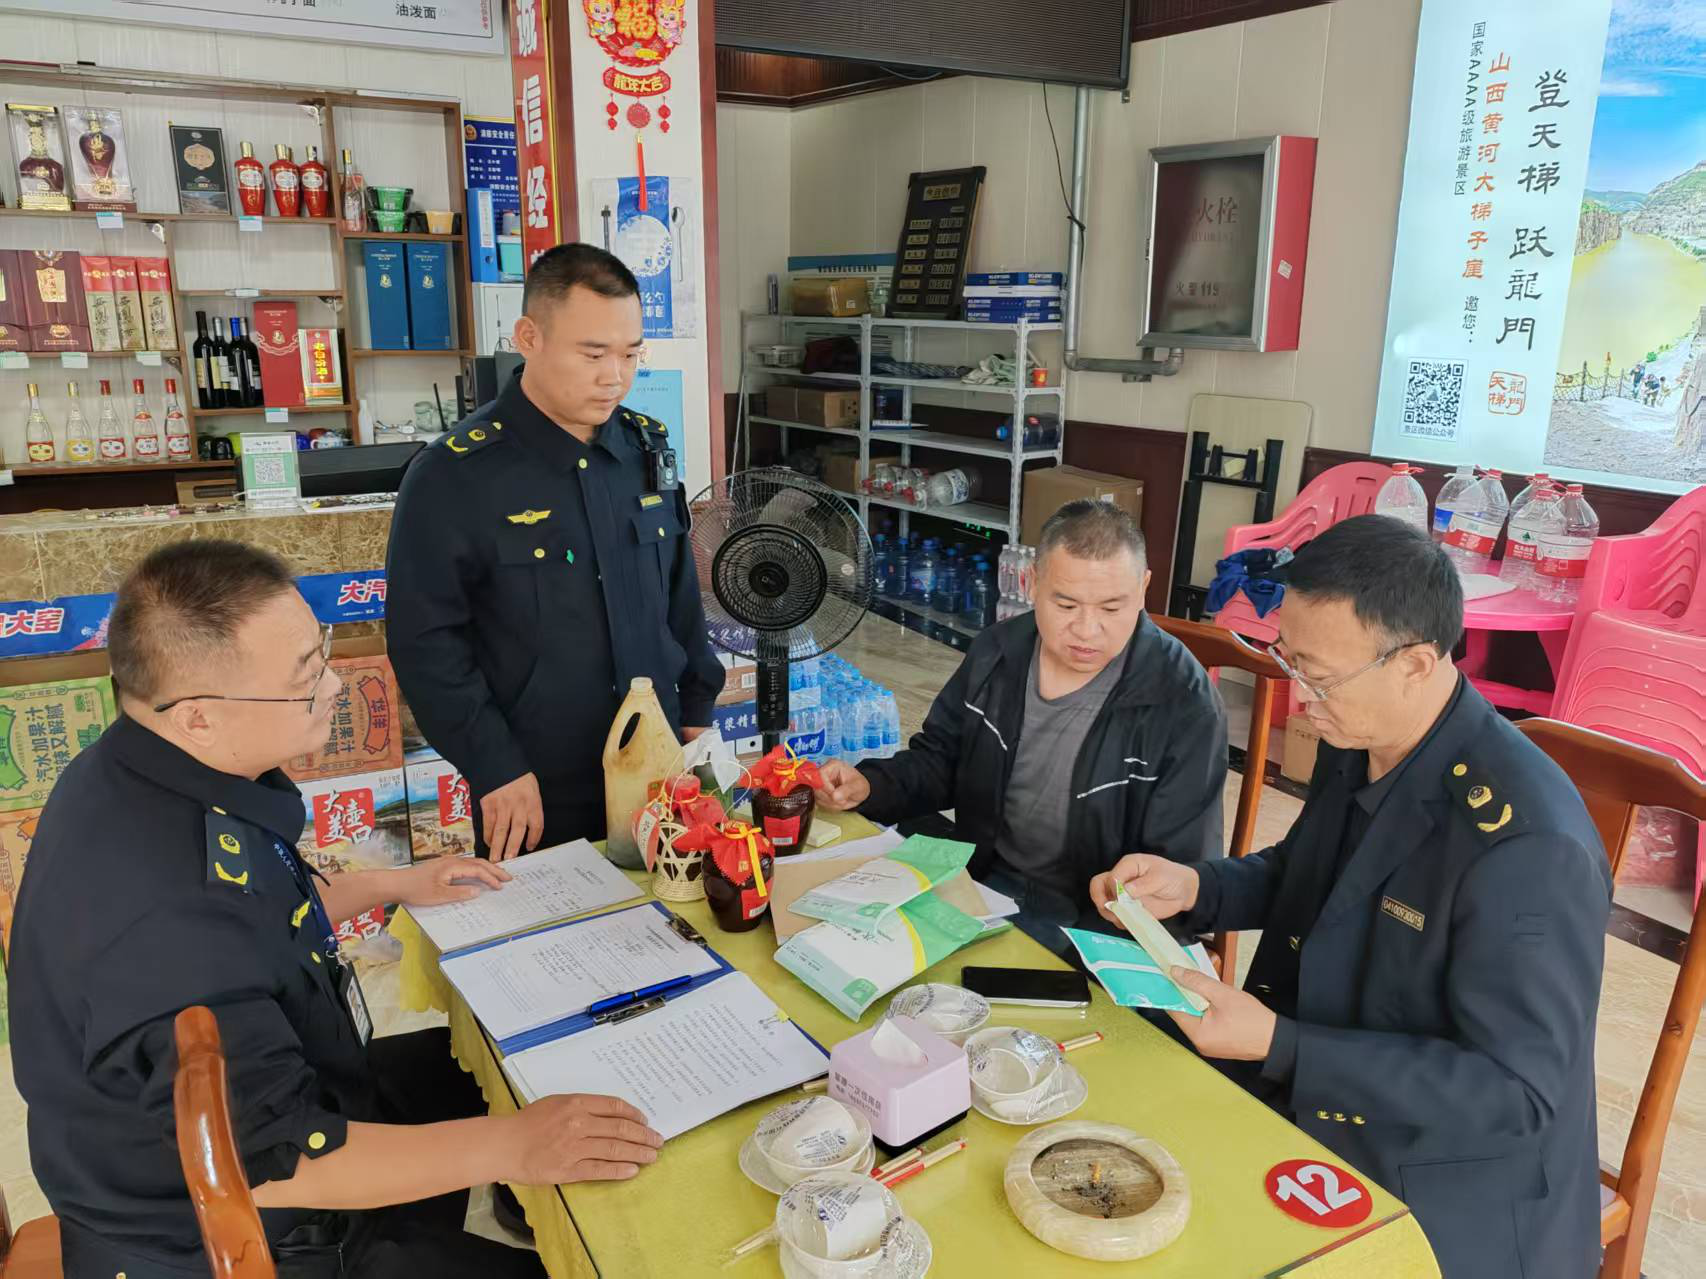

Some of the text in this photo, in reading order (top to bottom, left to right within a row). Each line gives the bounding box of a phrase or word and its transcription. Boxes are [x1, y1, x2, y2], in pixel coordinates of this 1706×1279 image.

[396, 3, 437, 20] 油泼面
[515, 0, 549, 264] 诚信经
[1454, 21, 1487, 196] 国家AAAA级旅游景区
[1517, 68, 1571, 195] 登天梯
[1462, 52, 1512, 279] 山西黄河大梯子崖
[1196, 196, 1240, 226] 火栓
[640, 290, 665, 305] 公勺
[25, 705, 55, 783] 汽水加果汁
[335, 682, 356, 753] 汽水加果汁
[1275, 1164, 1363, 1217] 12
